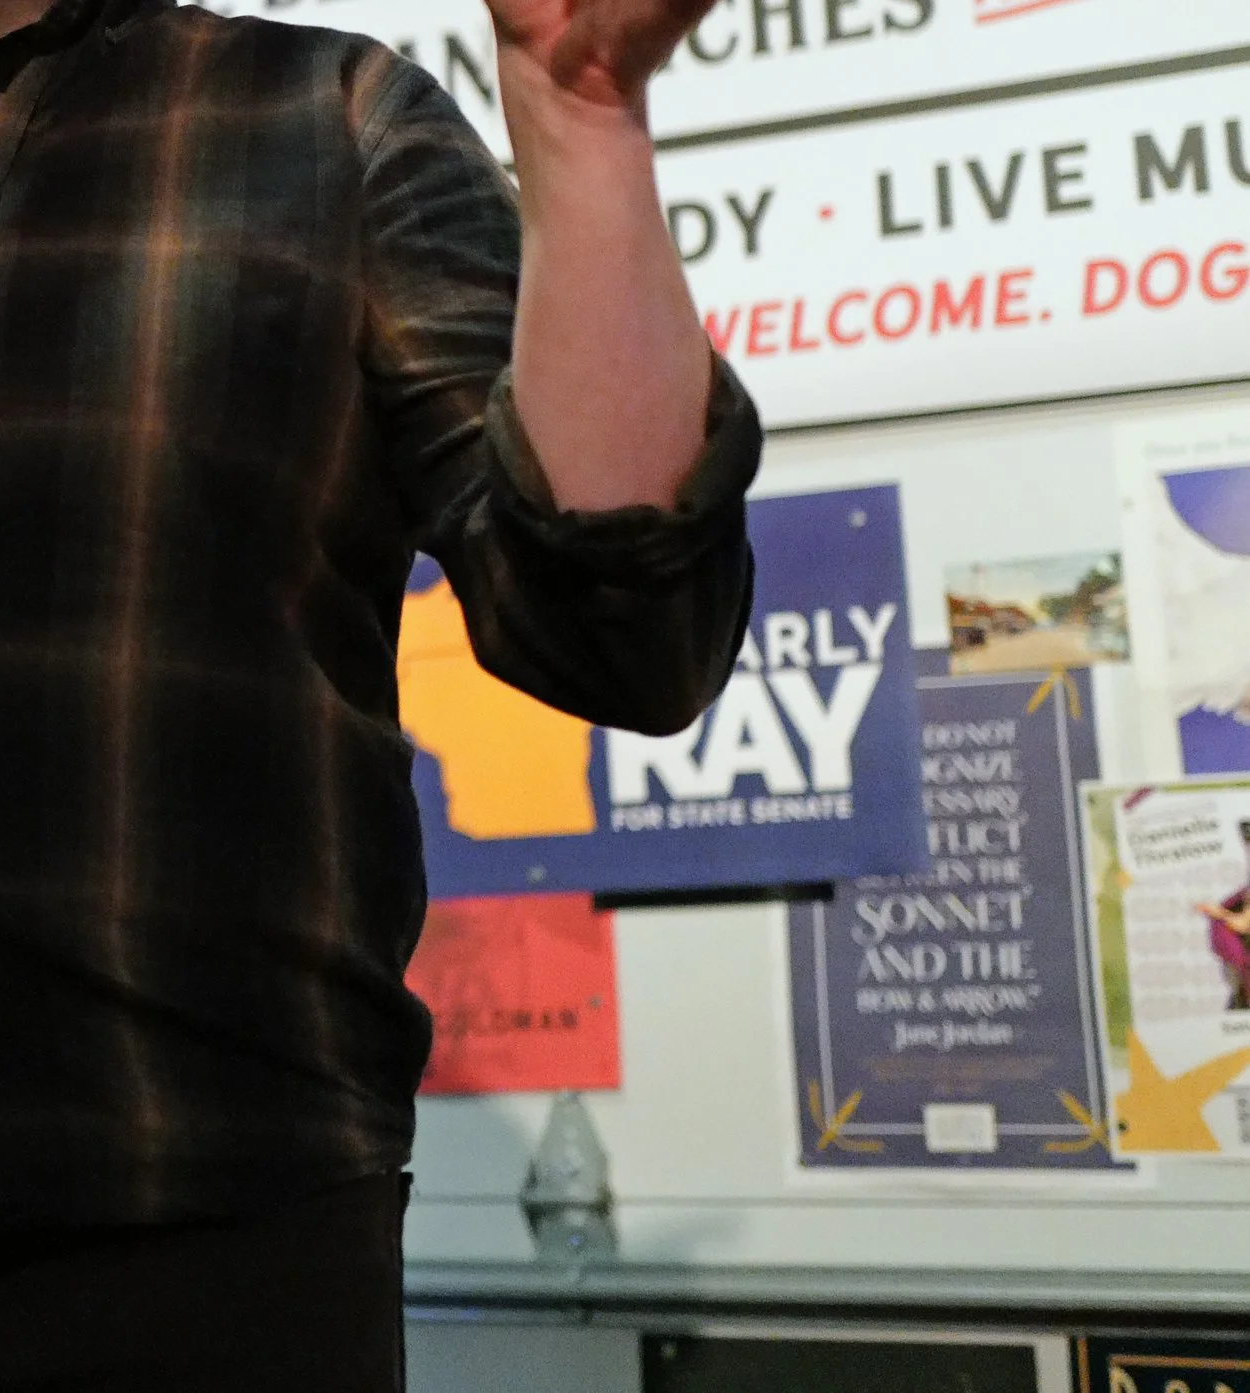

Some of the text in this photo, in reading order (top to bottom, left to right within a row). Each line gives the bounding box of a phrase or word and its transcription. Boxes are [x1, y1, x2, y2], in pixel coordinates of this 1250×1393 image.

[877, 142, 1094, 236] LIVE
[1081, 240, 1250, 317] DOG
[851, 884, 1033, 947] SONNET
[856, 941, 948, 984] AND
